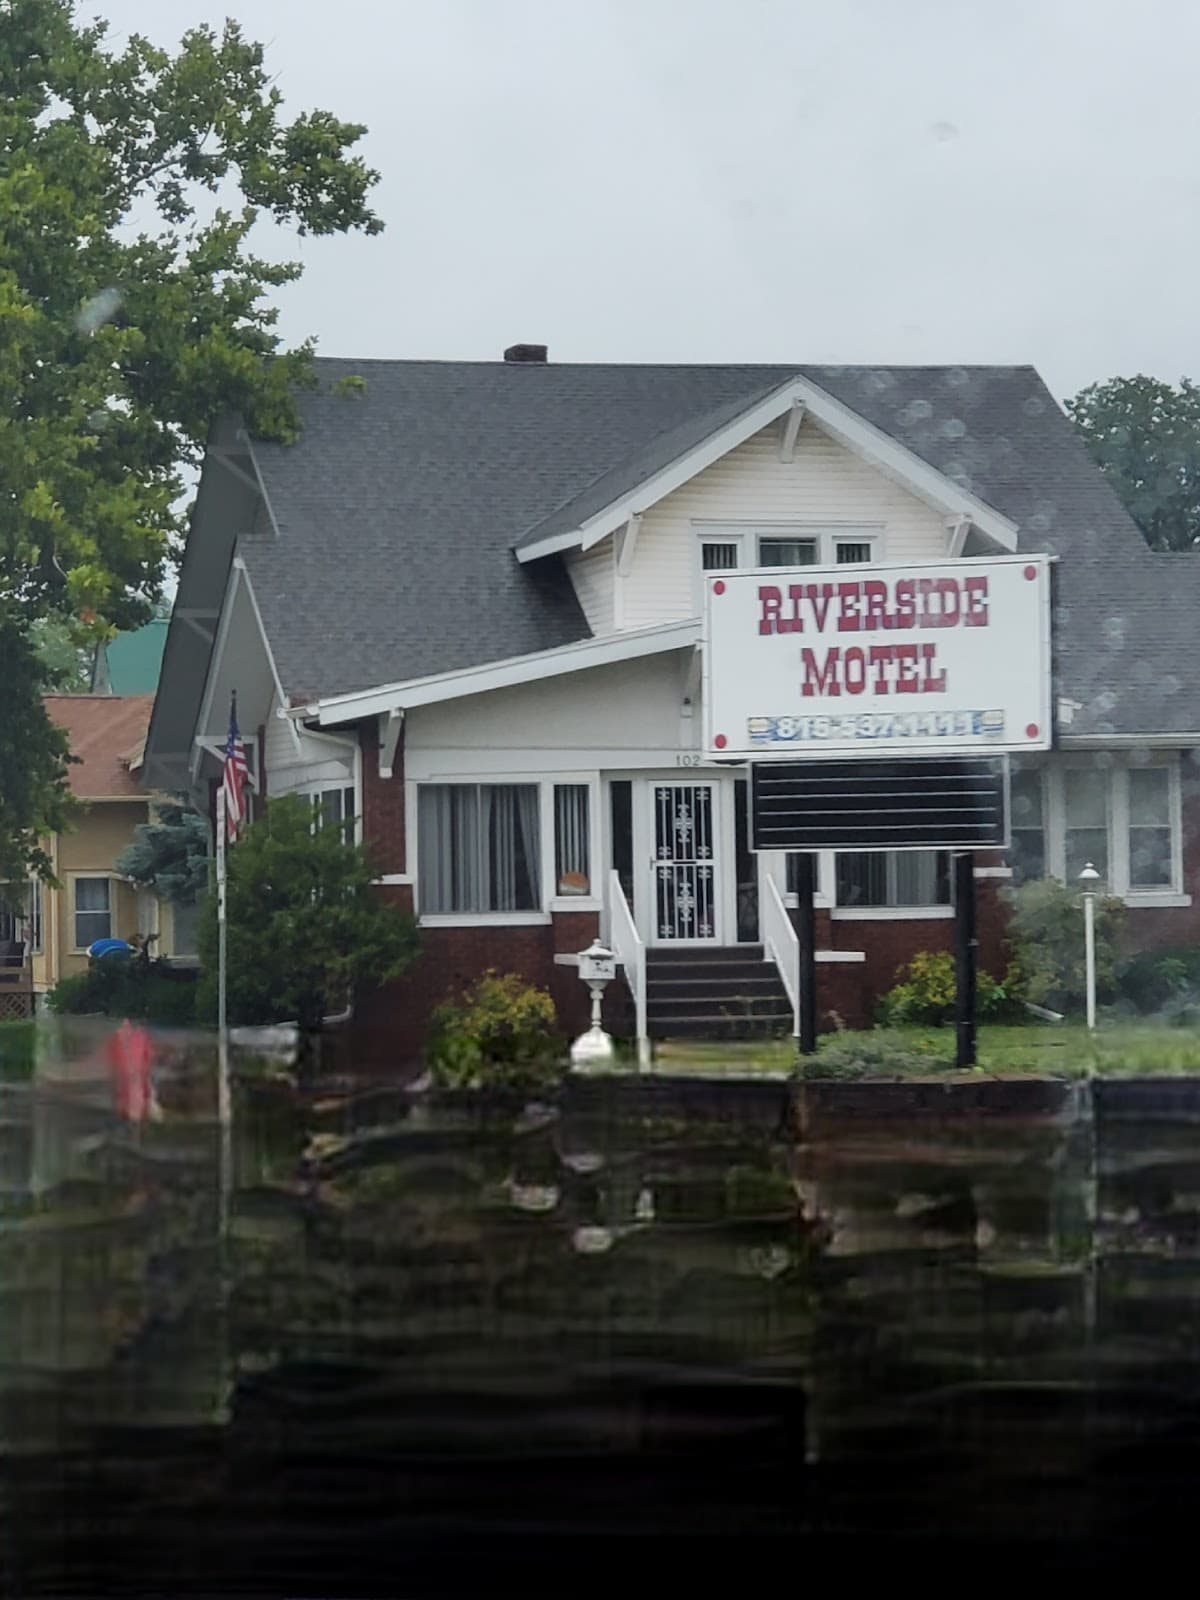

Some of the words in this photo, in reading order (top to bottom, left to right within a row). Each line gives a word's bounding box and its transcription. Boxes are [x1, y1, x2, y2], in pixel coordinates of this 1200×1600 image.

[758, 576, 989, 635] RIVERSIDE
[800, 643, 947, 696] MOTEL
[676, 755, 701, 767] 102
